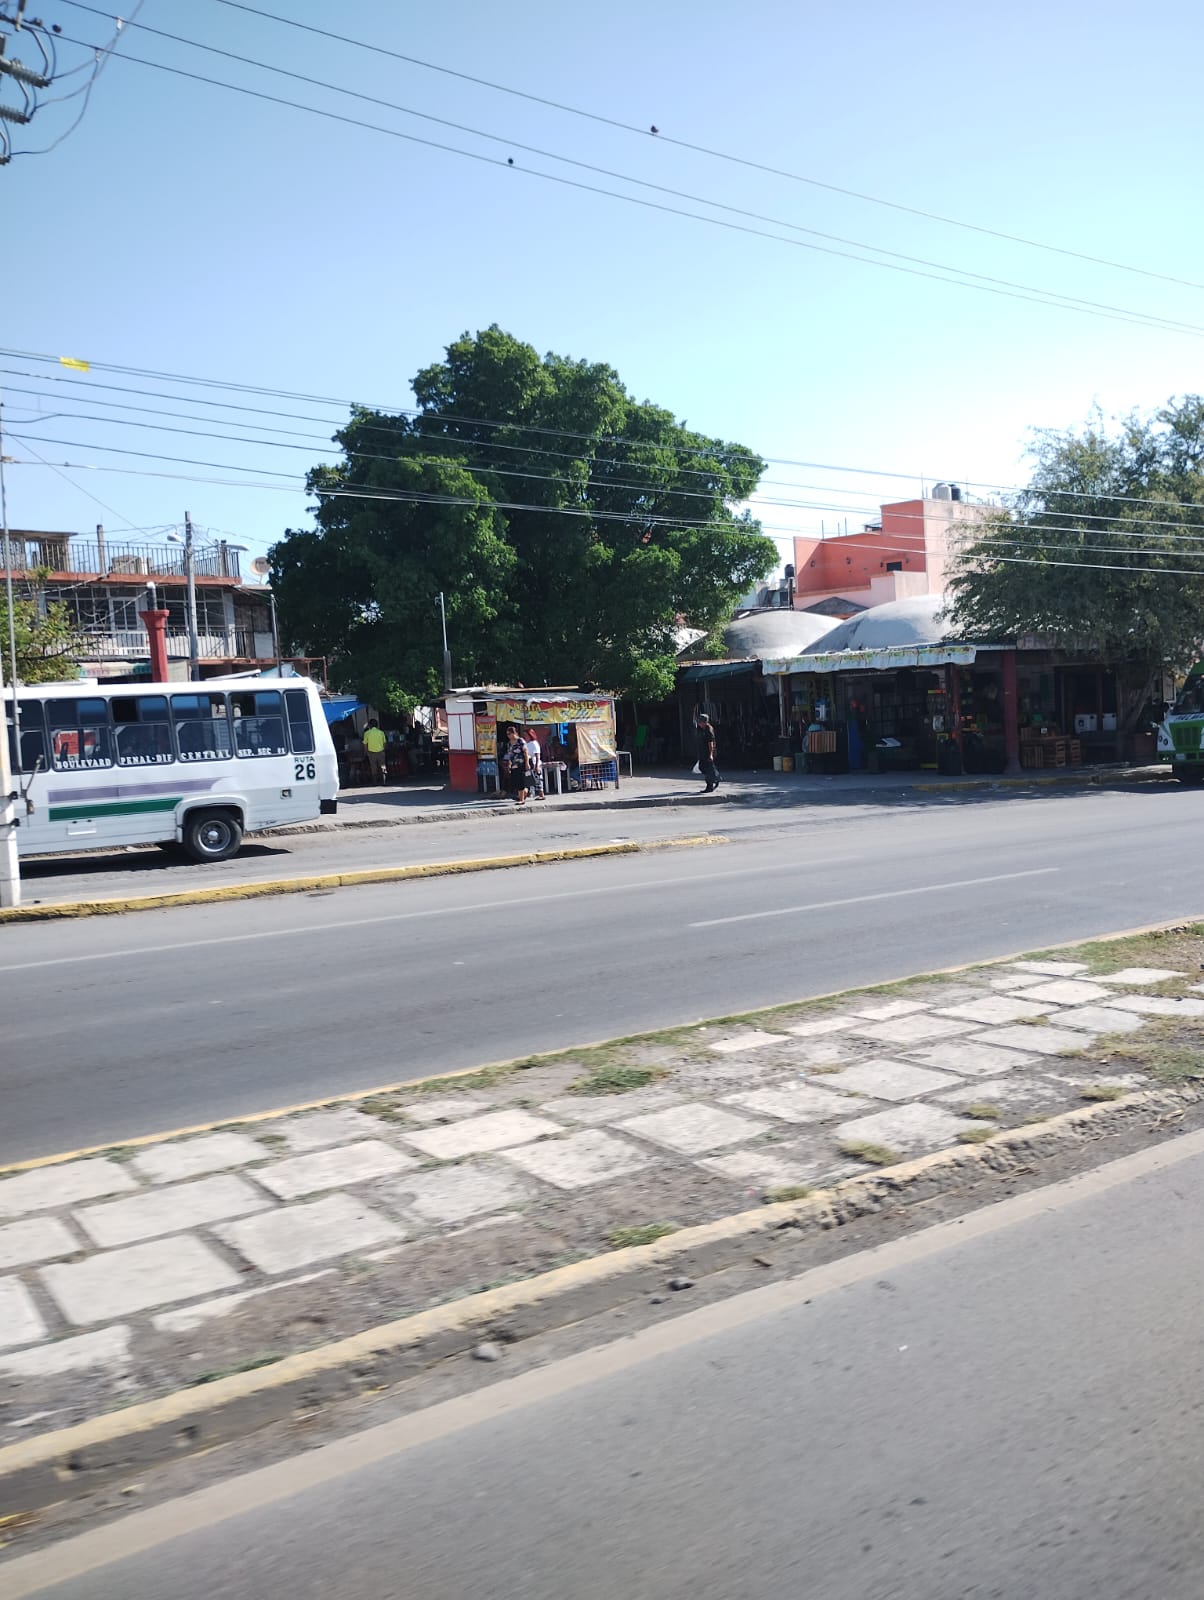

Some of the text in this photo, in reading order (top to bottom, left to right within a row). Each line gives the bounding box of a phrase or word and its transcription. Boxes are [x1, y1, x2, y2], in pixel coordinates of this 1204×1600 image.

[180, 749, 231, 760] CENTRAL
[55, 758, 112, 769] BOULEVARD
[295, 763, 316, 781] 26
